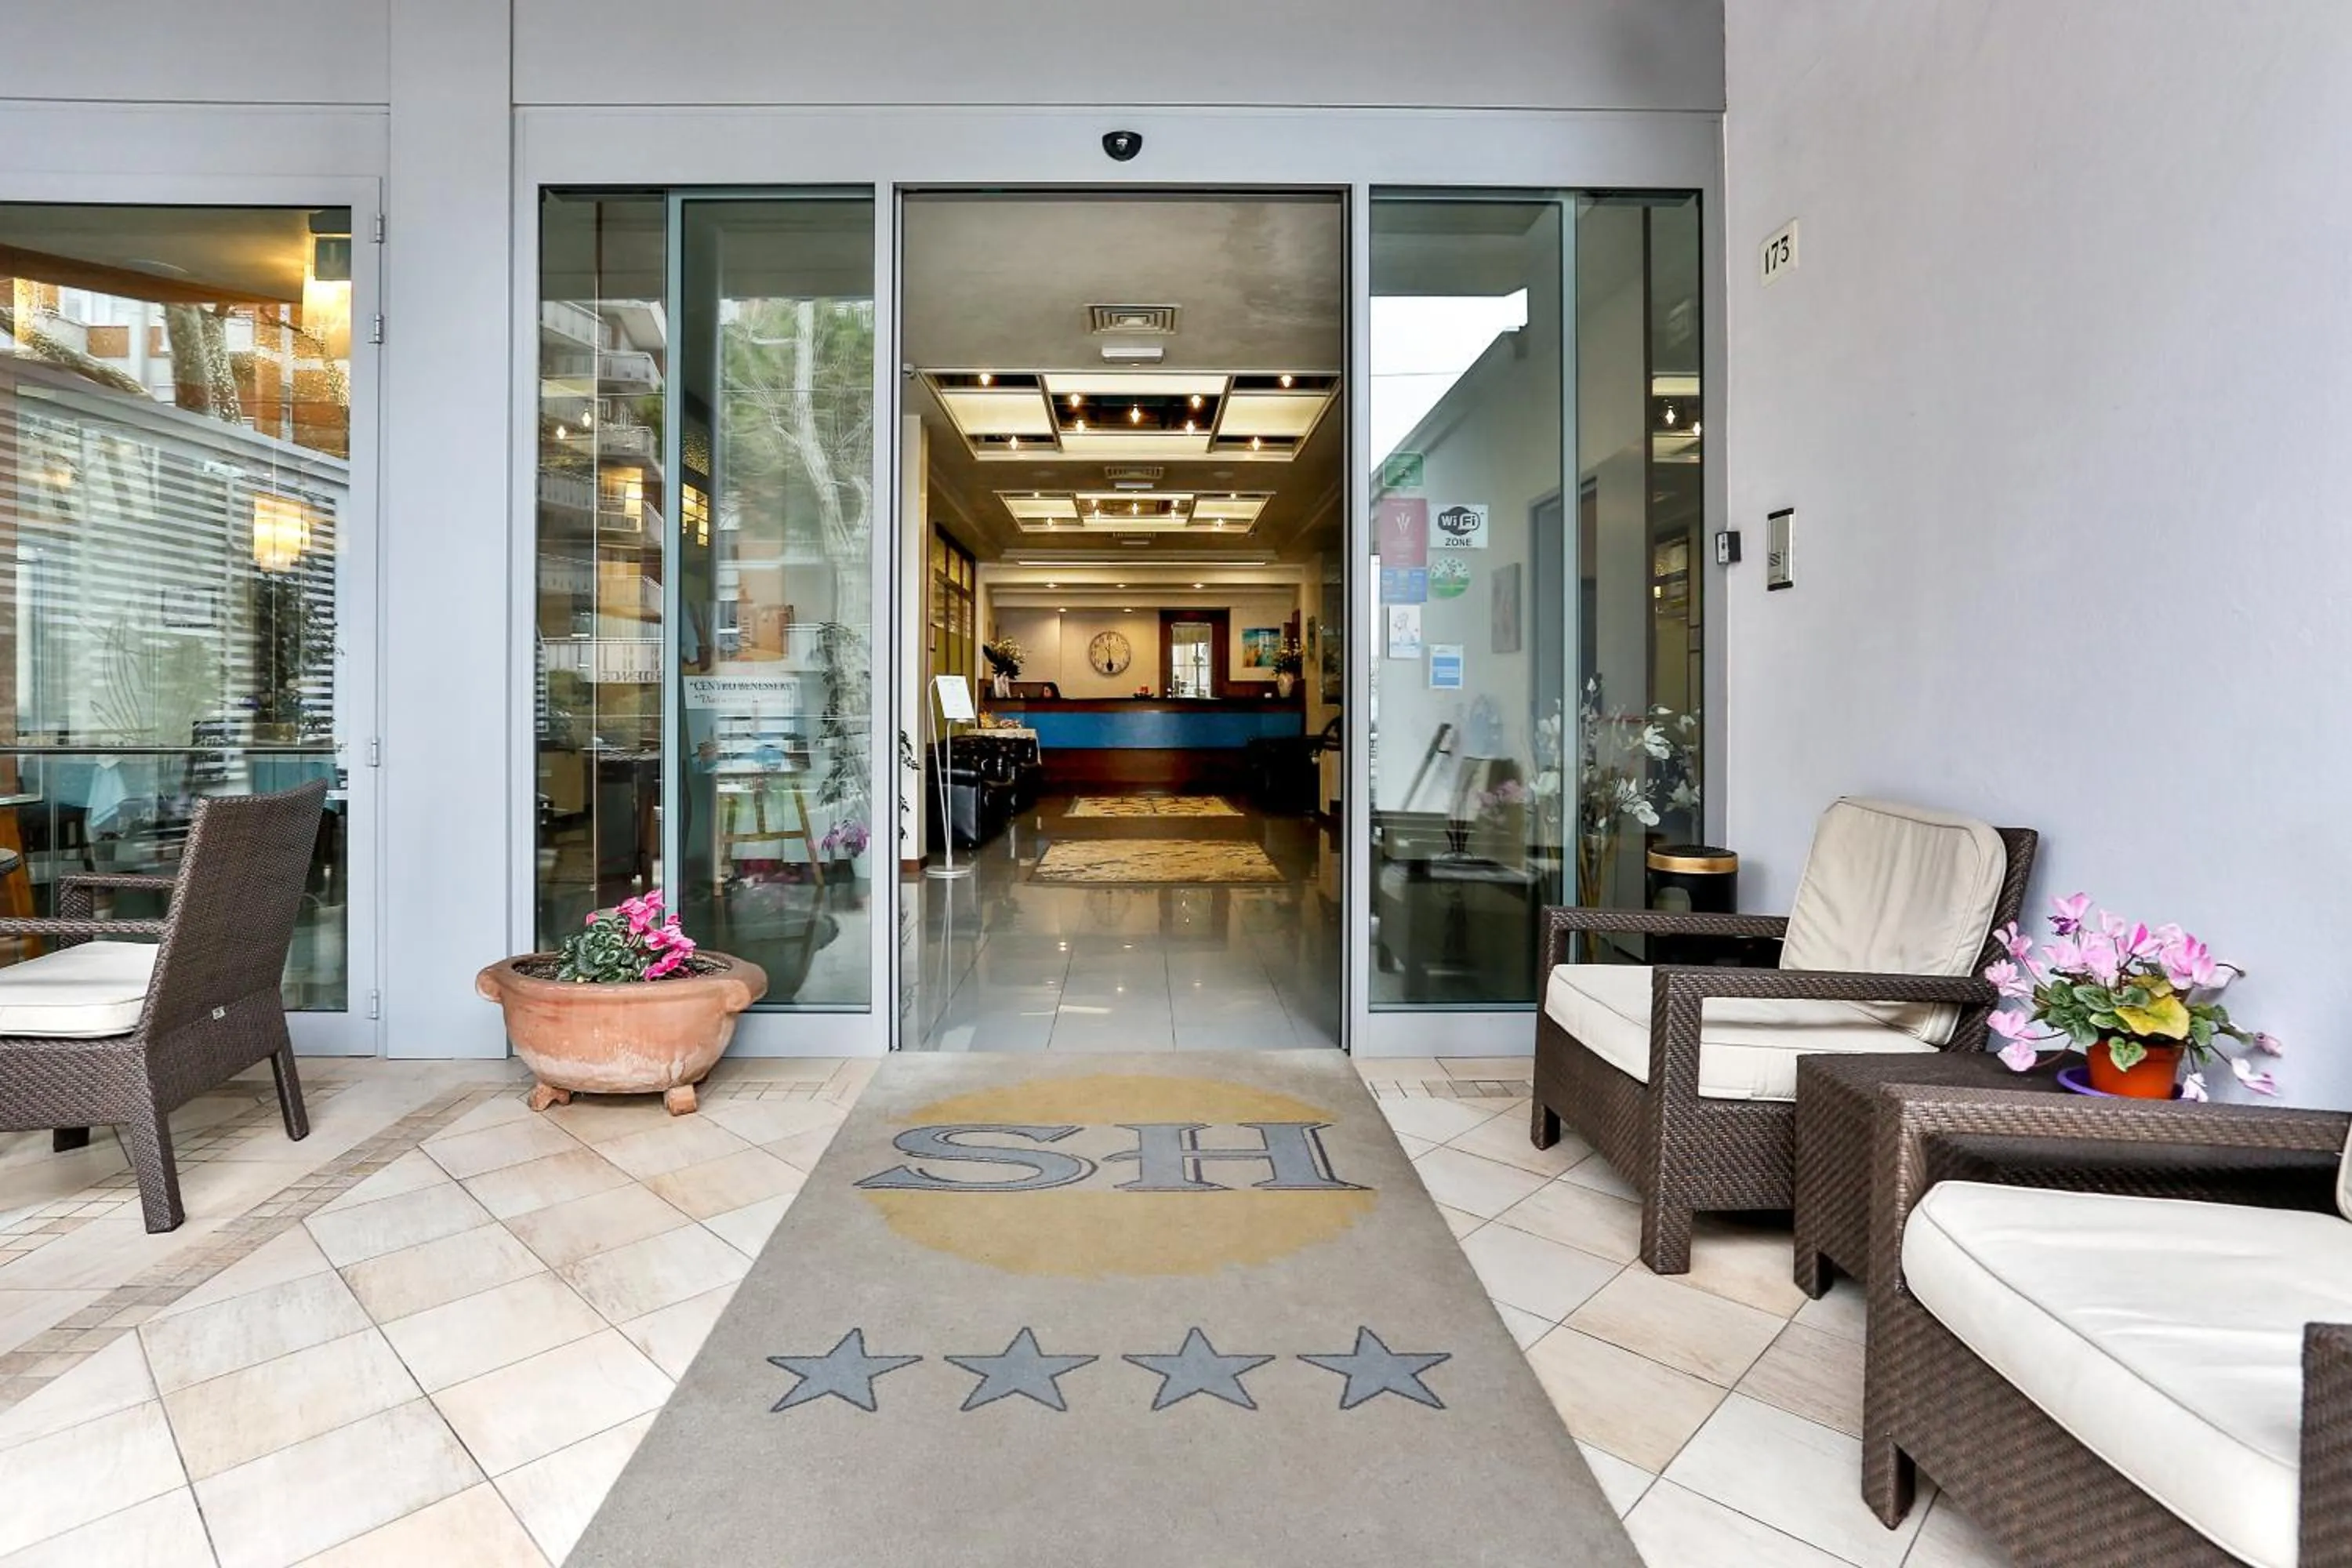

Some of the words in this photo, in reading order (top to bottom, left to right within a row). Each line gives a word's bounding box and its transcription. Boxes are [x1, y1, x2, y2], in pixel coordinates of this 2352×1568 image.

[1765, 234, 1790, 274] 173
[1445, 538, 1472, 546] ZONE
[853, 1122, 1374, 1192] SH
